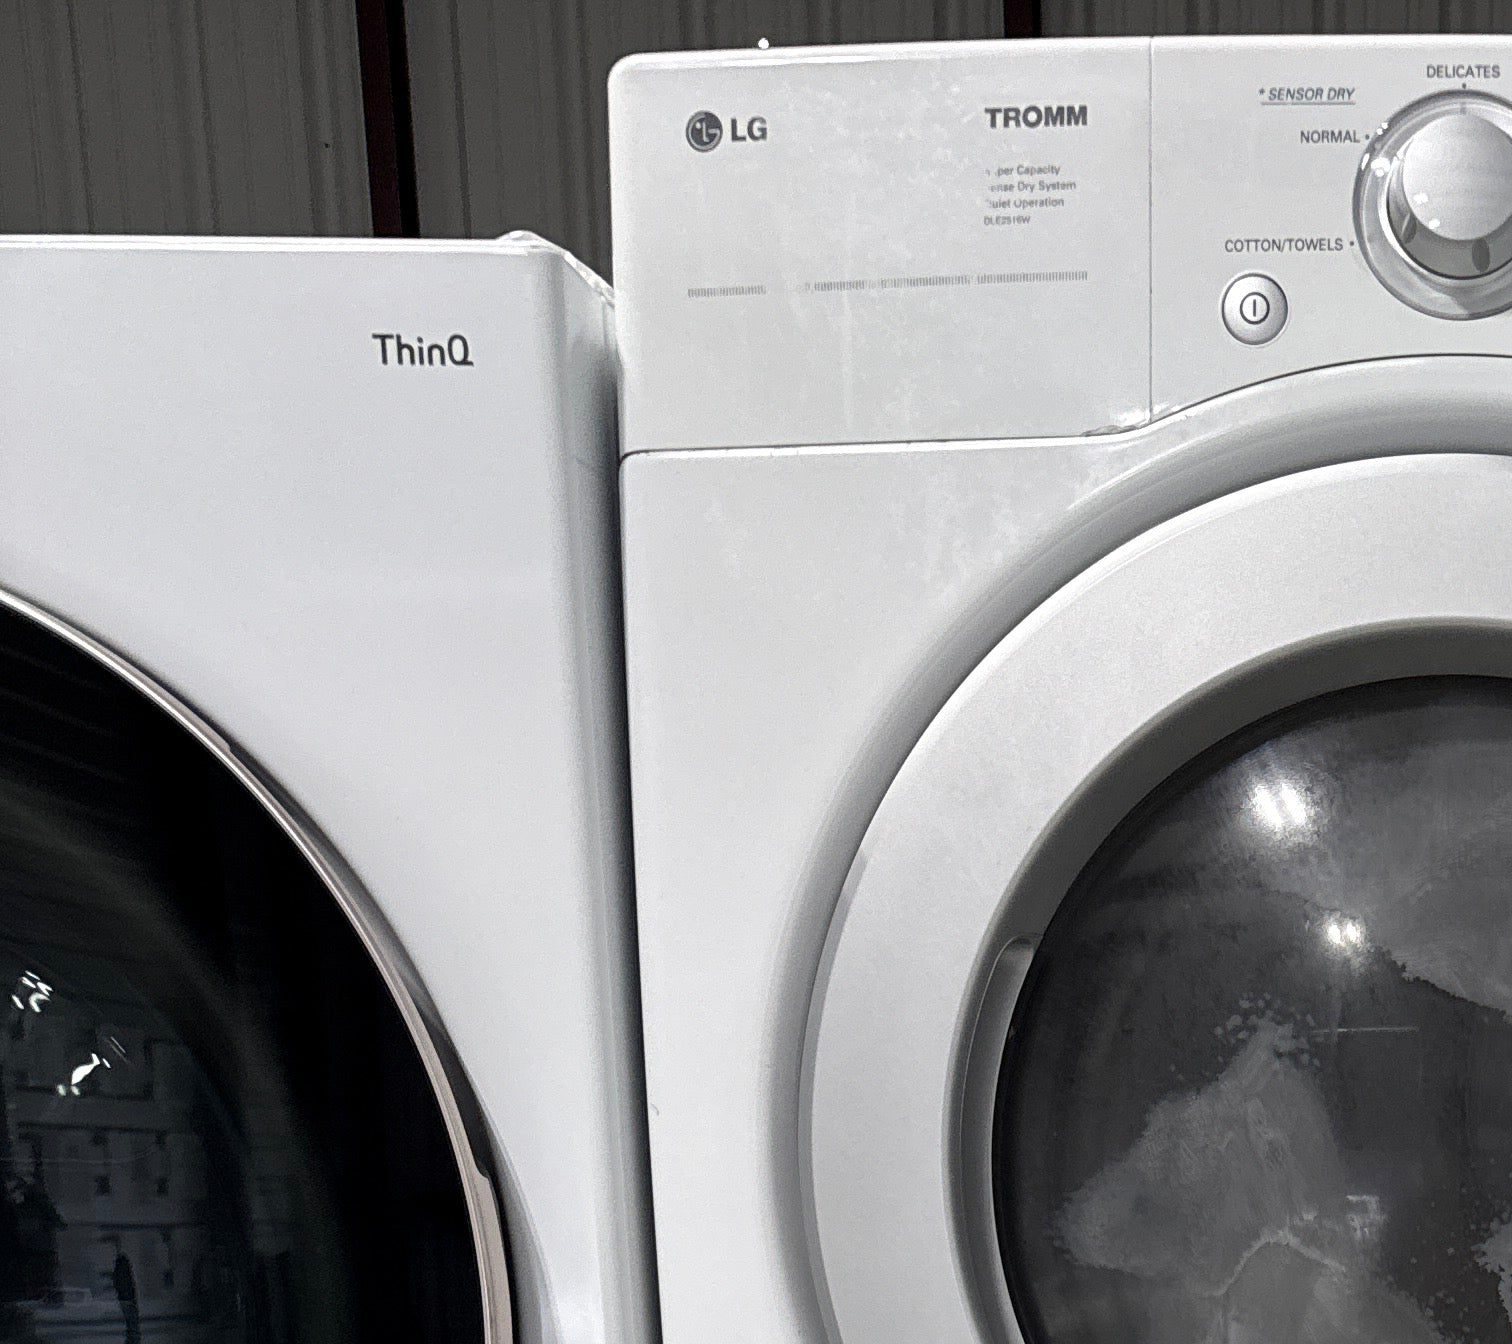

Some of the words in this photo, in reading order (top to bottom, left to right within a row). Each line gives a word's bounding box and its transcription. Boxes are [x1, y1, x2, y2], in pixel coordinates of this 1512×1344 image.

[1426, 64, 1501, 79] DELICATES
[1327, 87, 1356, 101] DRY
[984, 105, 1088, 128] TROMM
[730, 116, 768, 142] LG
[1299, 130, 1361, 144] NORMAL
[1016, 164, 1061, 177] Capacity
[1017, 181, 1035, 193] Dry
[1038, 180, 1077, 192] System
[1224, 237, 1344, 252] COTTON/TOWELS
[372, 333, 475, 367] ThinQ
